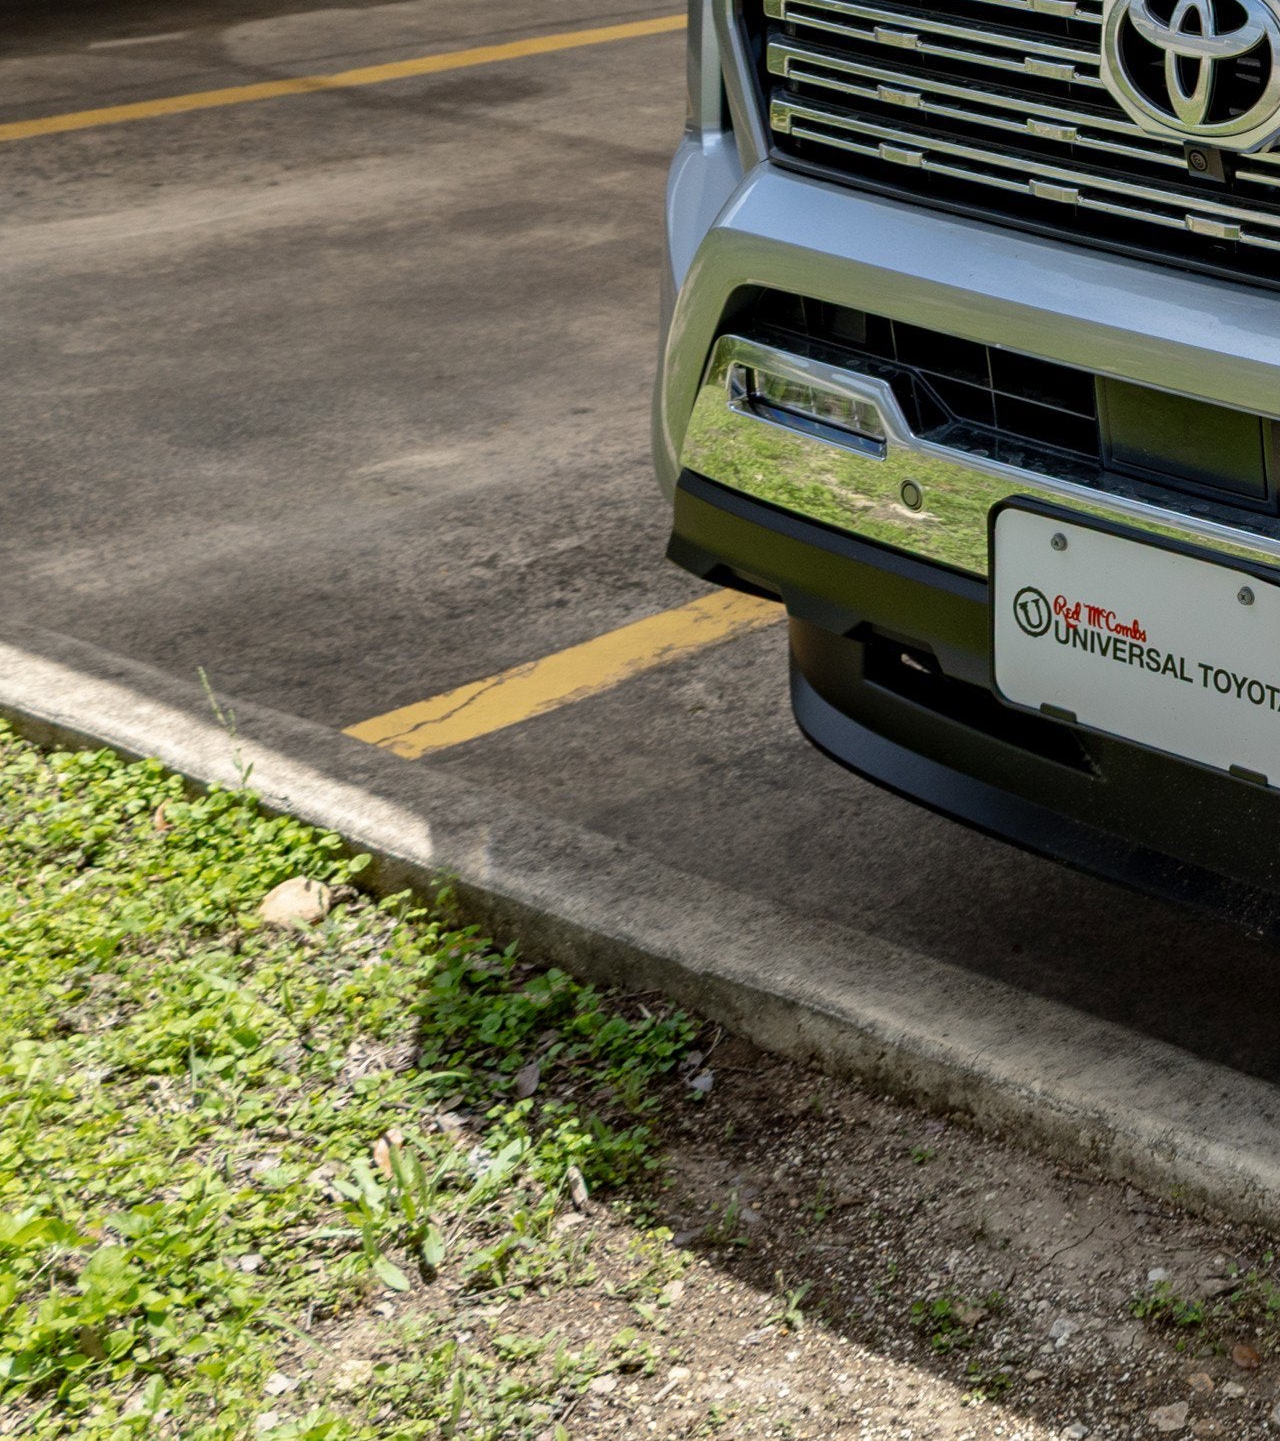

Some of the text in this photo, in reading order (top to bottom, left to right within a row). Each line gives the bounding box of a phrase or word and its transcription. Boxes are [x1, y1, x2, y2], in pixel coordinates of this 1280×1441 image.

[1053, 594, 1147, 643] Red McCombs
[1055, 619, 1193, 684] UNIVERSAL
